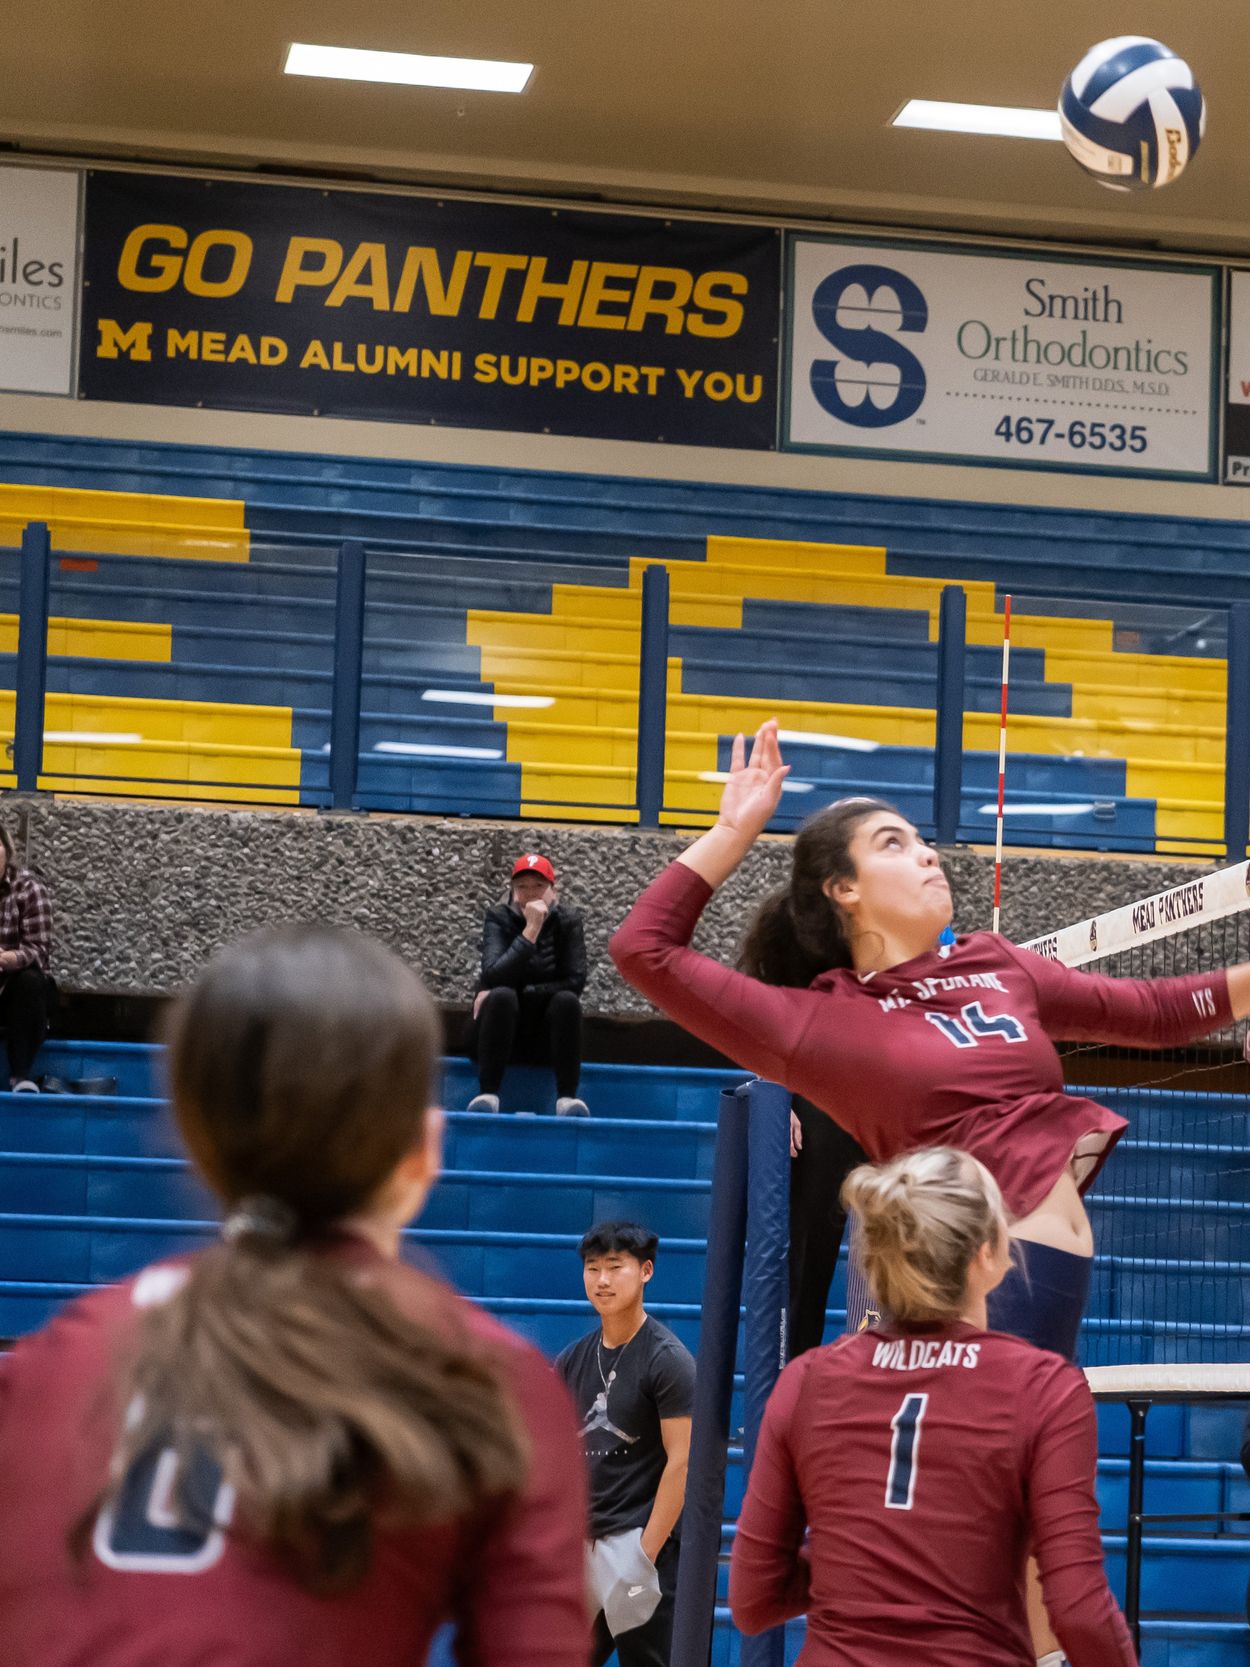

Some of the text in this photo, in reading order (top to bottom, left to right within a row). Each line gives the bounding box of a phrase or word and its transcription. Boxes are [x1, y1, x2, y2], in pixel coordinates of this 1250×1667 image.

[117, 224, 749, 338] GO PANTHERS
[1023, 278, 1124, 325] Smith
[97, 318, 763, 403] M MEAD ALUMNI SUPPORT YOU
[956, 320, 1190, 376] Orthodontics
[973, 368, 1030, 386] GERALD
[1046, 374, 1089, 391] SMITH
[994, 415, 1148, 454] 467-6535
[1132, 881, 1204, 934] MEAD PANTHERS
[872, 1340, 981, 1371] WILDCATS
[884, 1393, 929, 1510] 1
